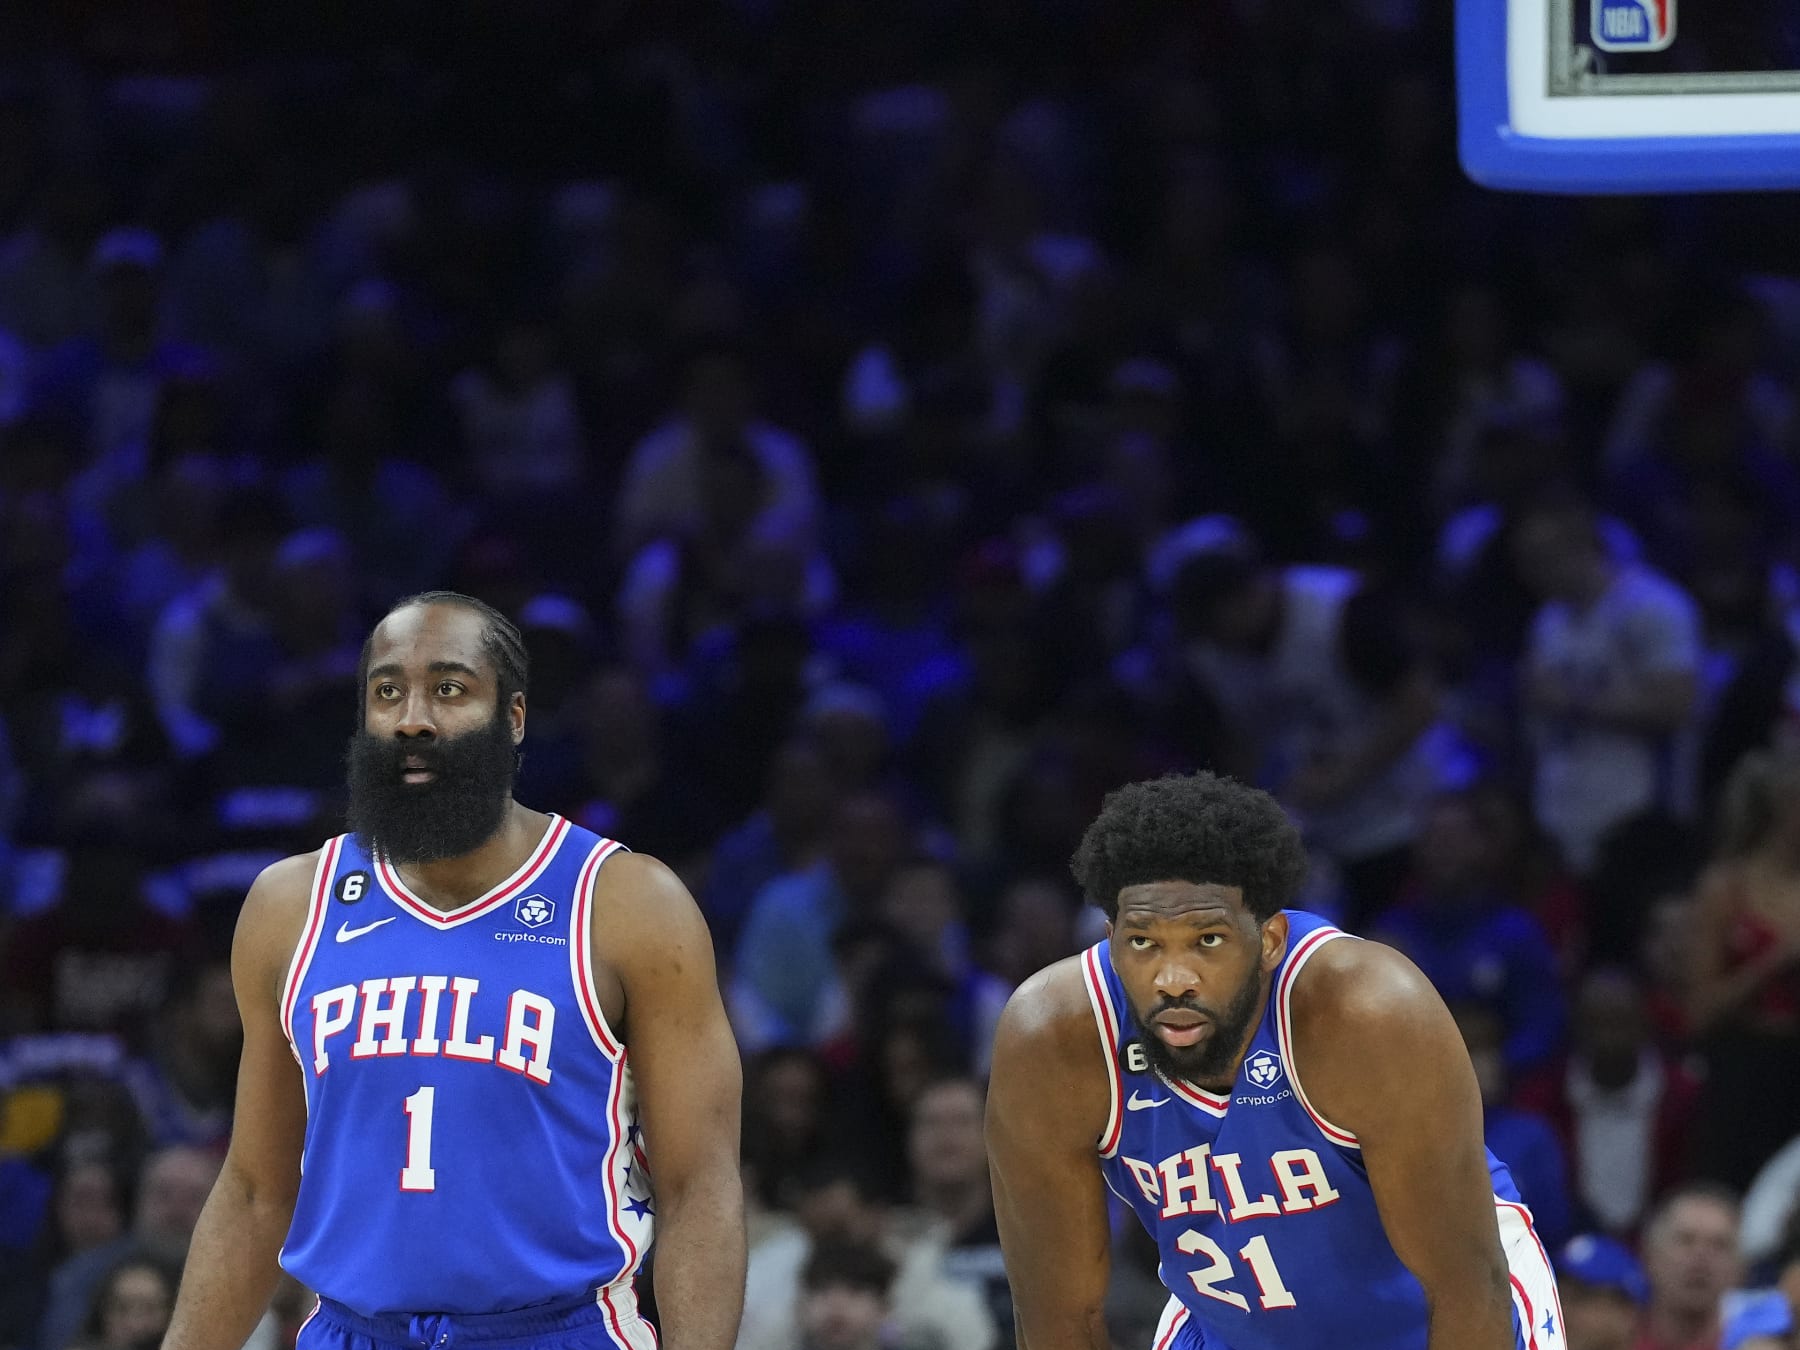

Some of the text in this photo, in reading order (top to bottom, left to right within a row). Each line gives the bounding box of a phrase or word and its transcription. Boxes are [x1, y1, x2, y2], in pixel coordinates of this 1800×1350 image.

[1604, 7, 1643, 37] NBA
[341, 875, 364, 901] 6
[494, 932, 566, 946] crypto.com
[310, 975, 556, 1086] PHILA
[1127, 1043, 1149, 1072] 6
[1236, 1090, 1292, 1106] crypto.co
[399, 1086, 435, 1192] 1
[1121, 1142, 1340, 1224] PHLA
[1176, 1228, 1297, 1313] 21
